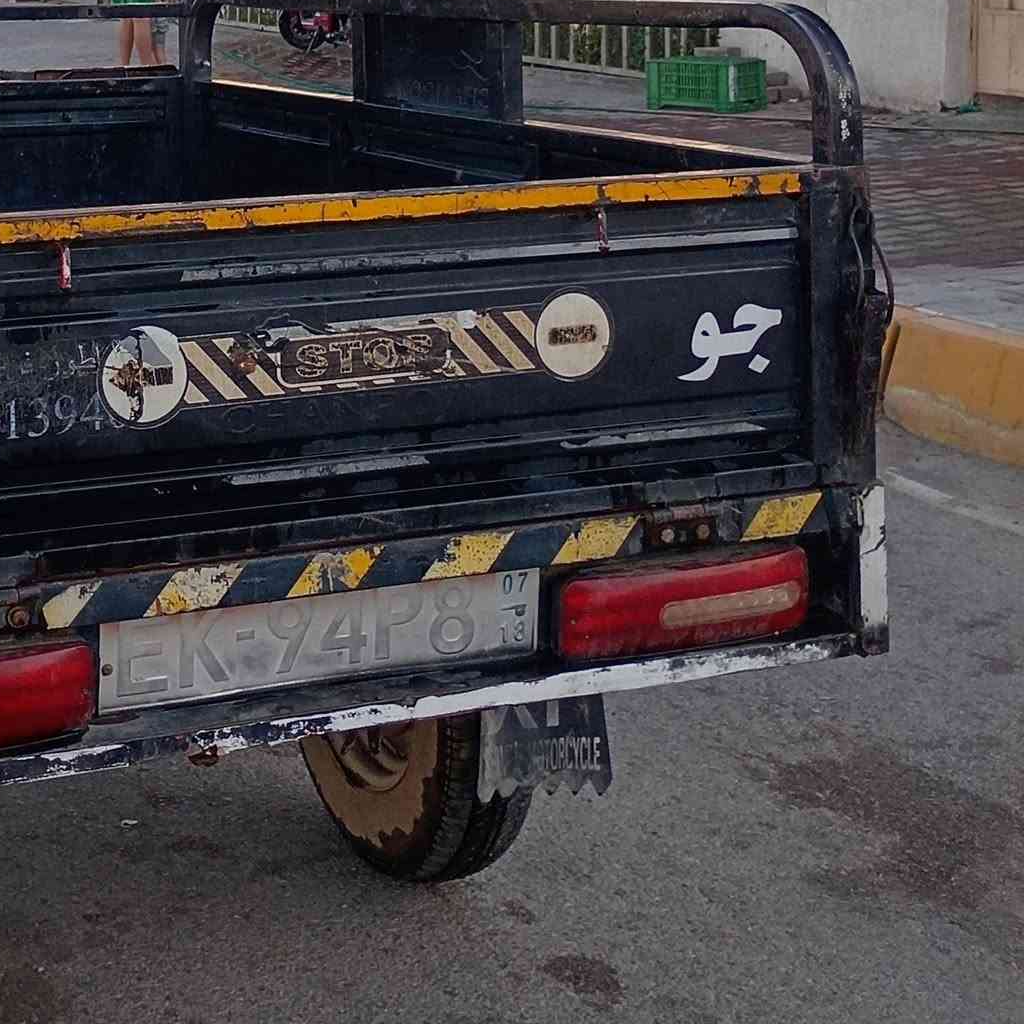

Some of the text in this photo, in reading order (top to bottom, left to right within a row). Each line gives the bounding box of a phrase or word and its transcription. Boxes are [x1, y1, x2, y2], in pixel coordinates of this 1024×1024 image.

[676, 303, 782, 381] جو
[503, 572, 529, 594] 07
[116, 585, 475, 697] EK-94P8
